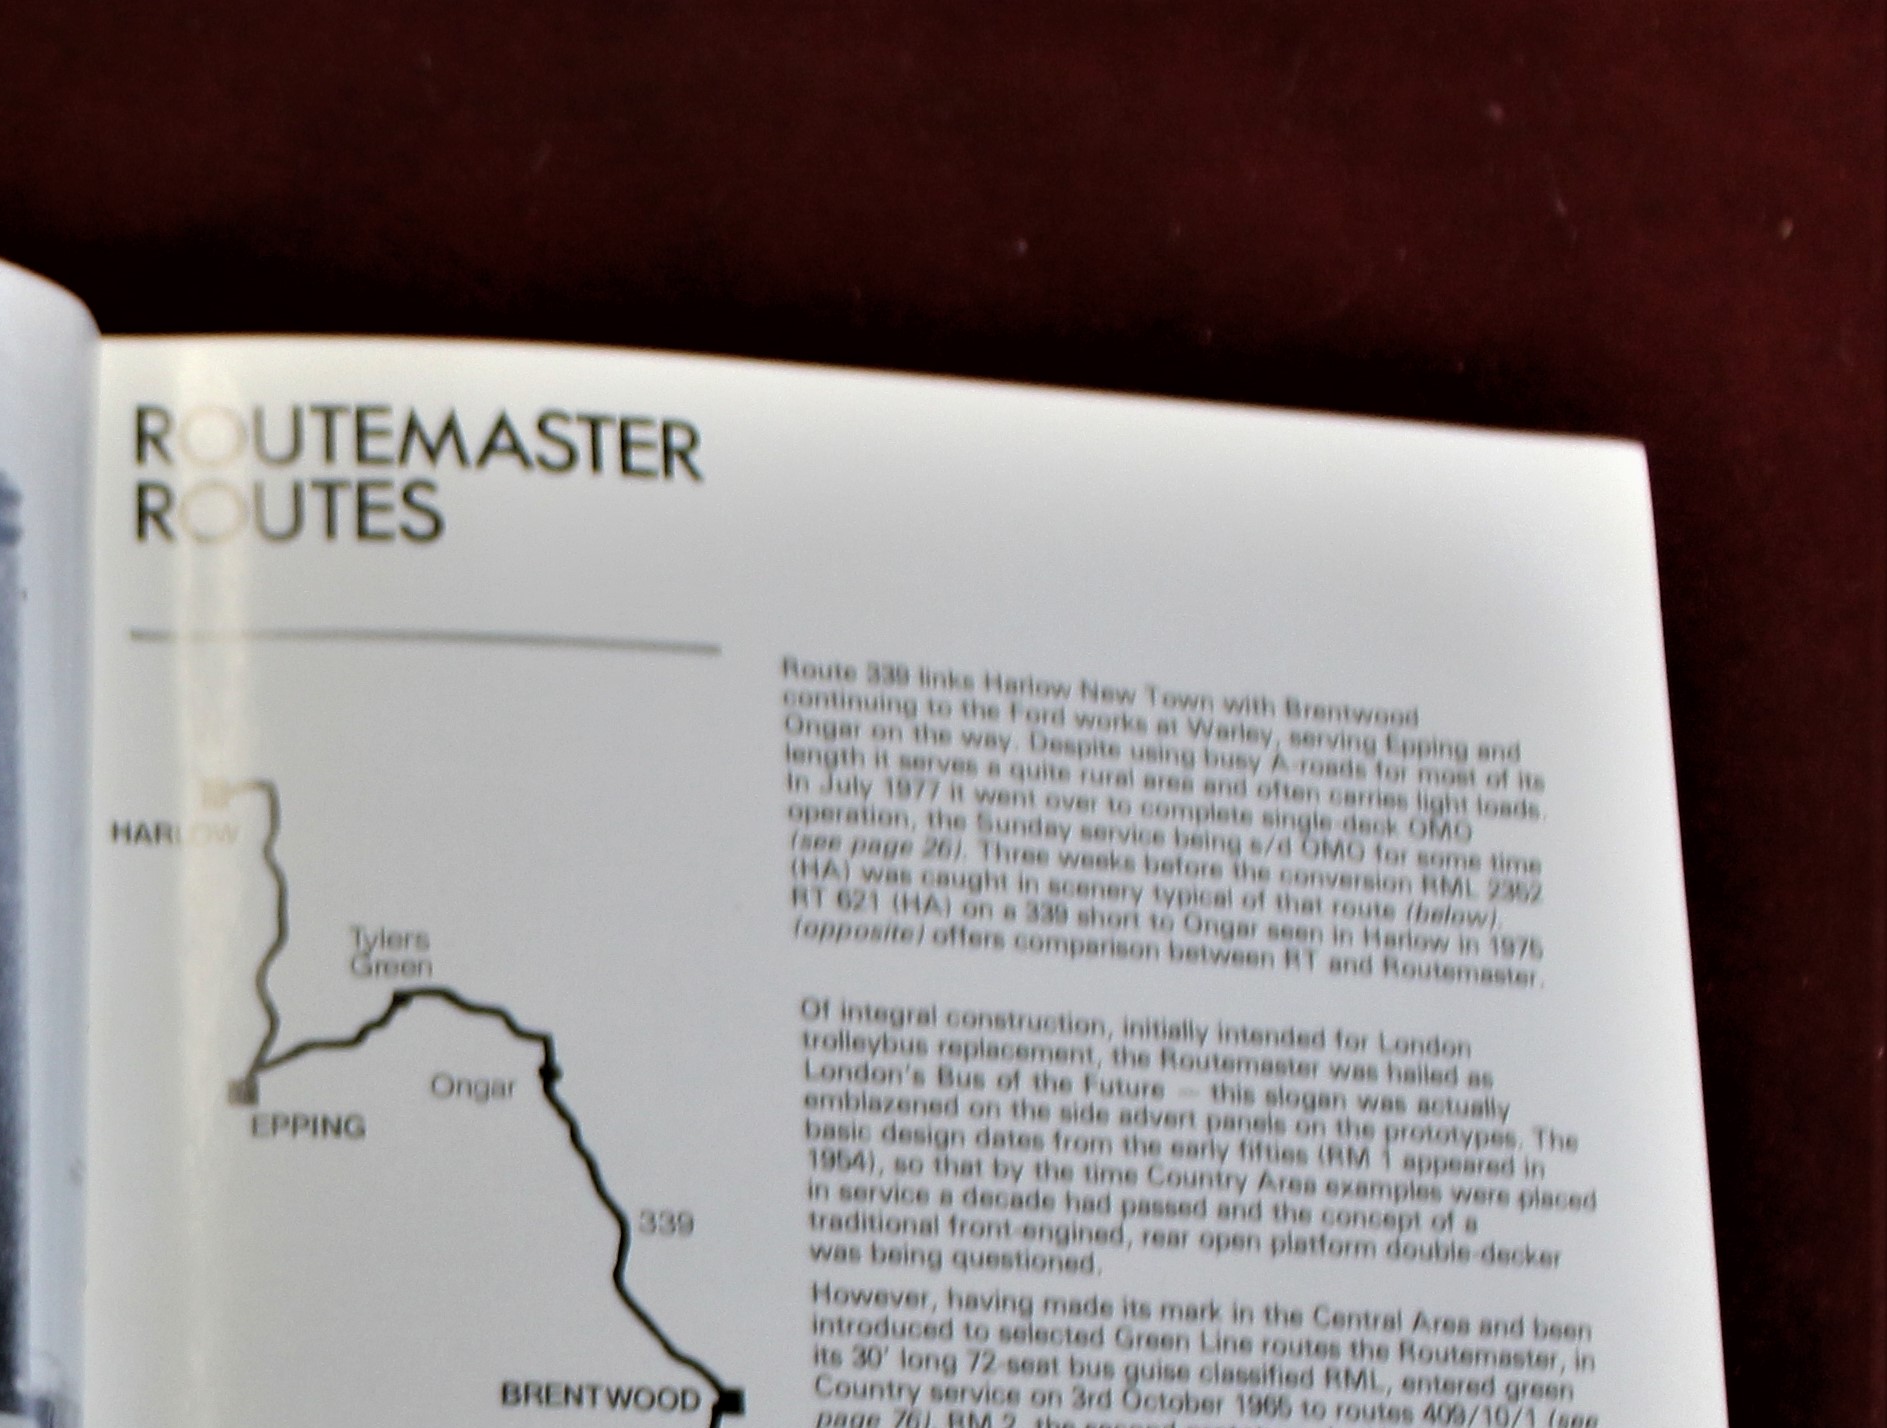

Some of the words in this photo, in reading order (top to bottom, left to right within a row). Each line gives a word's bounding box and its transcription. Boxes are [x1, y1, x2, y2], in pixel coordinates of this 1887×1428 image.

[134, 403, 704, 481] ROUTEMASTER
[134, 479, 446, 543] ROUTES
[780, 653, 856, 681] Route
[917, 664, 974, 690] links
[982, 669, 1070, 698] Harlow
[1078, 678, 1135, 704] New
[1145, 683, 1213, 710] Town
[1222, 689, 1275, 715] with
[1283, 694, 1418, 726] Brentwood
[782, 682, 917, 721] continuing
[925, 693, 952, 717] to
[959, 696, 999, 721] the
[1009, 700, 1065, 726] Ford
[1073, 705, 1147, 733] works
[1154, 712, 1177, 735] at
[1186, 714, 1279, 748] Warley,
[1288, 722, 1376, 756] serving
[1384, 730, 1468, 764] Epping
[1476, 737, 1521, 762] and
[782, 711, 859, 744] Ongar
[870, 721, 902, 742] on
[911, 721, 951, 746] the
[1028, 730, 1120, 764] Despite
[1129, 738, 1195, 771] using
[1202, 744, 1259, 776] busy
[1373, 757, 1406, 781] for
[1416, 759, 1476, 785] most
[1485, 765, 1508, 788] of
[1516, 767, 1545, 790] its
[787, 797, 916, 833] operation,
[926, 807, 966, 832] the
[975, 810, 1070, 845] Sunday
[1079, 818, 1165, 846] service
[1173, 825, 1241, 857] being
[1373, 840, 1406, 864] for
[1415, 847, 1481, 869] some
[1489, 848, 1541, 873] time
[860, 863, 912, 885] was
[920, 864, 1007, 897] caught
[1017, 870, 1038, 894] in
[1047, 876, 1142, 907] scenery
[1151, 880, 1232, 913] typical
[1241, 886, 1265, 909] of
[1274, 888, 1322, 913] that
[1331, 893, 1395, 919] route
[350, 926, 430, 957] Tylers
[350, 953, 432, 979] Green
[793, 913, 924, 950] (opposite)
[931, 923, 1004, 949] offers
[1013, 928, 1159, 966] comparison
[1167, 939, 1274, 967] between
[1283, 946, 1314, 970] RT
[1327, 950, 1373, 974] and
[799, 994, 829, 1018] Of
[839, 996, 937, 1030] integral
[945, 1003, 1112, 1038] construction,
[1122, 1015, 1207, 1048] initially
[1217, 1020, 1325, 1049] intended
[1334, 1028, 1366, 1051] for
[1377, 1031, 1471, 1058] London
[801, 1024, 927, 1059] trolleybus
[937, 1032, 1100, 1069] replacement,
[1111, 1042, 1150, 1066] the
[1159, 1045, 1317, 1077] Routemaster
[1328, 1060, 1378, 1081] was
[1386, 1060, 1458, 1086] hailed
[1466, 1069, 1493, 1088] as
[431, 1073, 516, 1102] Ongar
[251, 1114, 366, 1141] EPPING
[892, 1153, 924, 1173] so
[932, 1151, 982, 1176] that
[992, 1155, 1022, 1184] by
[1033, 1156, 1073, 1180] the
[1082, 1159, 1137, 1184] time
[1146, 1163, 1246, 1196] Country
[1257, 1169, 1316, 1194] Area
[1325, 1173, 1441, 1207] examples
[1449, 1184, 1510, 1205] were
[1516, 1184, 1597, 1216] placed
[639, 1210, 695, 1236] 339
[808, 1204, 939, 1233] traditional
[1141, 1227, 1187, 1247] rear
[1198, 1230, 1260, 1257] open
[1270, 1230, 1376, 1263] platform
[808, 1241, 861, 1262] was
[869, 1240, 942, 1272] being
[811, 1279, 934, 1309] However,
[946, 1286, 1033, 1318] having
[1042, 1291, 1113, 1316] made
[1121, 1294, 1151, 1317] its
[1159, 1296, 1220, 1321] mark
[1231, 1300, 1254, 1323] in
[1262, 1302, 1303, 1325] the
[1312, 1304, 1402, 1330] Central
[1411, 1310, 1470, 1334] Area
[1478, 1313, 1524, 1337] and
[1532, 1316, 1591, 1340] been
[811, 1310, 953, 1339] introduced
[962, 1317, 989, 1340] to
[998, 1319, 1104, 1346] selected
[1113, 1325, 1190, 1350] Green
[1199, 1329, 1252, 1353] Line
[1261, 1332, 1340, 1358] routes
[1348, 1336, 1389, 1359] the
[1398, 1338, 1562, 1370] Routemaster,
[1573, 1347, 1595, 1370] in
[501, 1381, 700, 1412] BRENTWOOD
